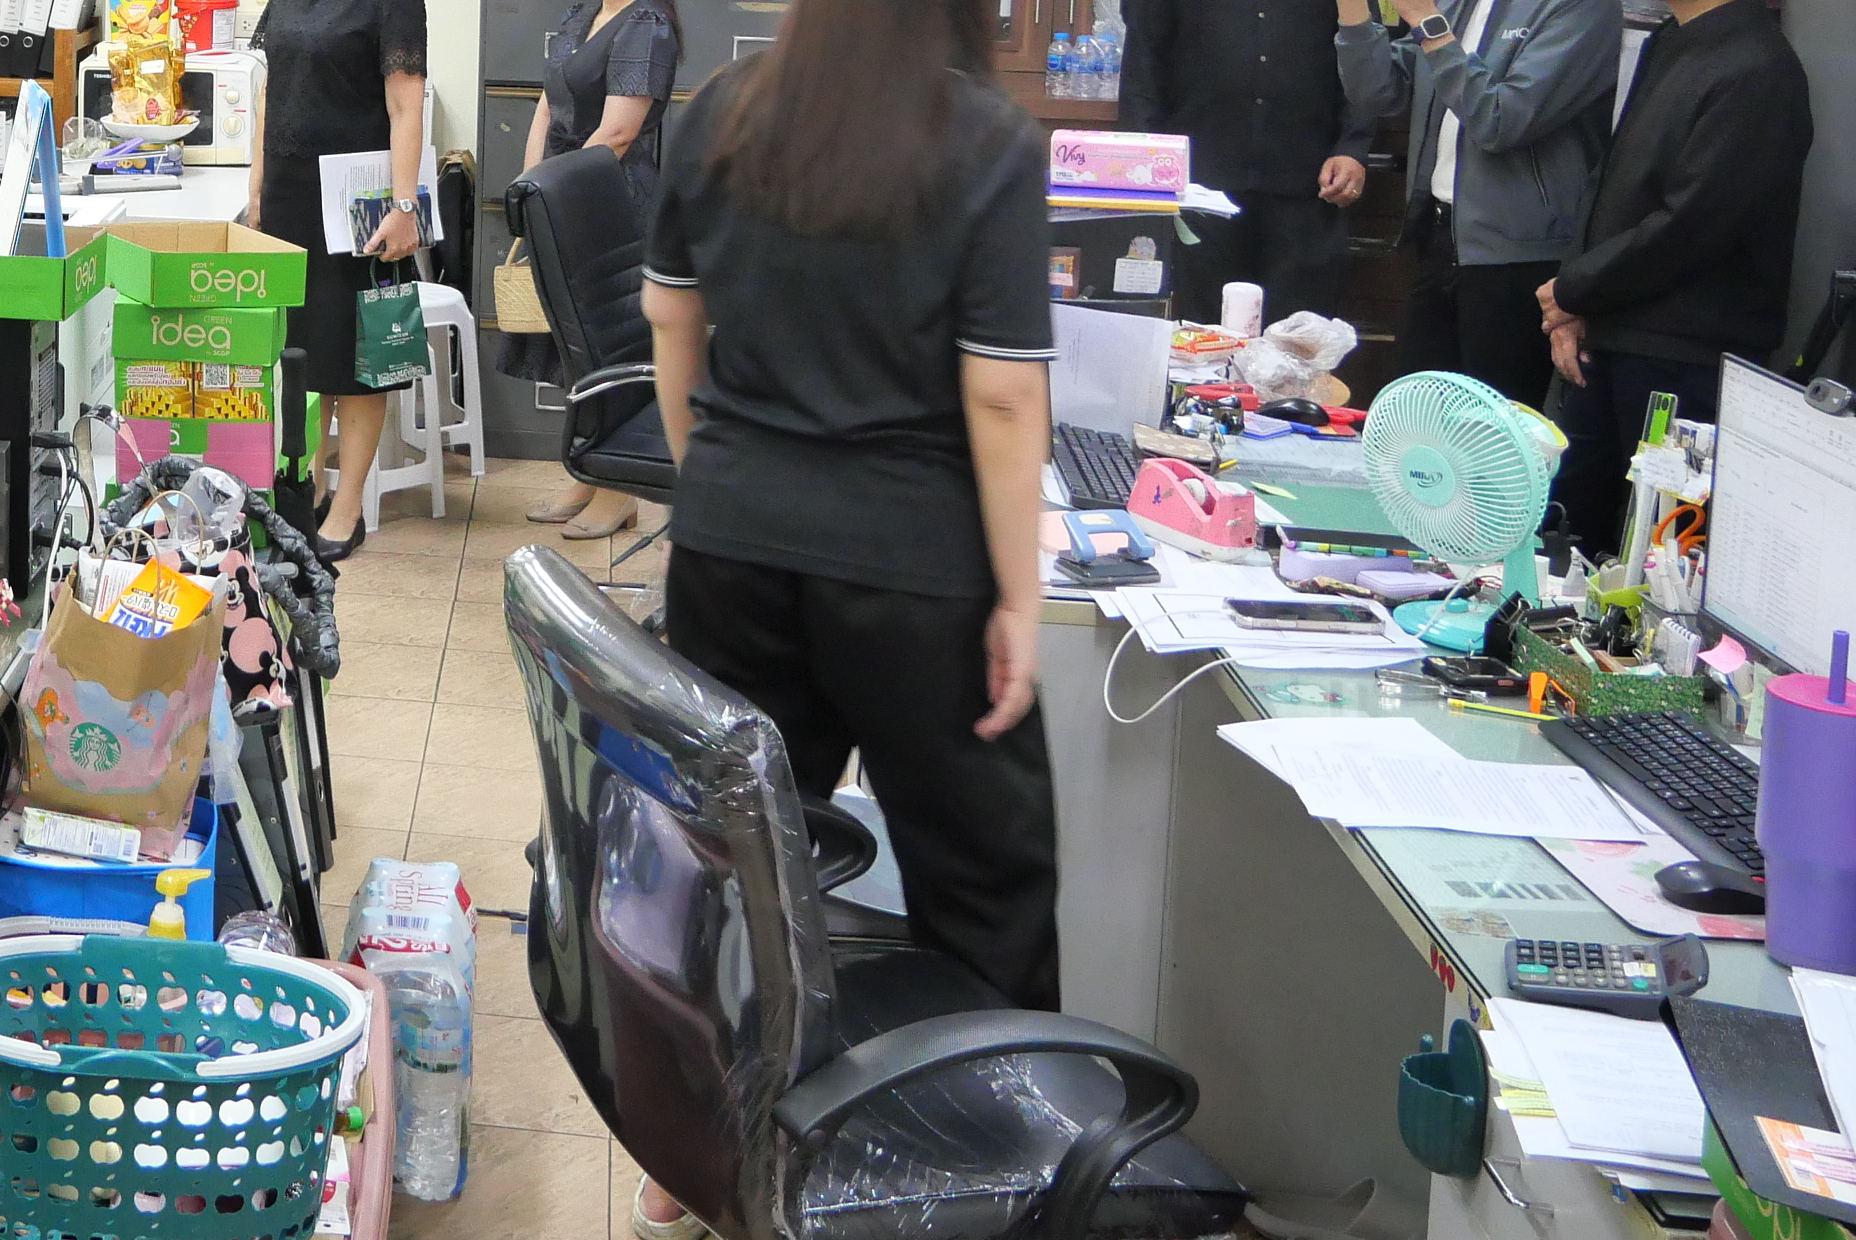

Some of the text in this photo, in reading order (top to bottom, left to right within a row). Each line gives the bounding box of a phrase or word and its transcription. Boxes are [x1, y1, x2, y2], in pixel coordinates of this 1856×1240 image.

[1055, 144, 1086, 166] Vivy
[75, 254, 98, 295] idea
[189, 268, 267, 302] idea
[189, 293, 217, 303] GREEN
[150, 313, 231, 349] idea
[203, 315, 233, 325] GREEN
[122, 594, 179, 619] ロース塩バター
